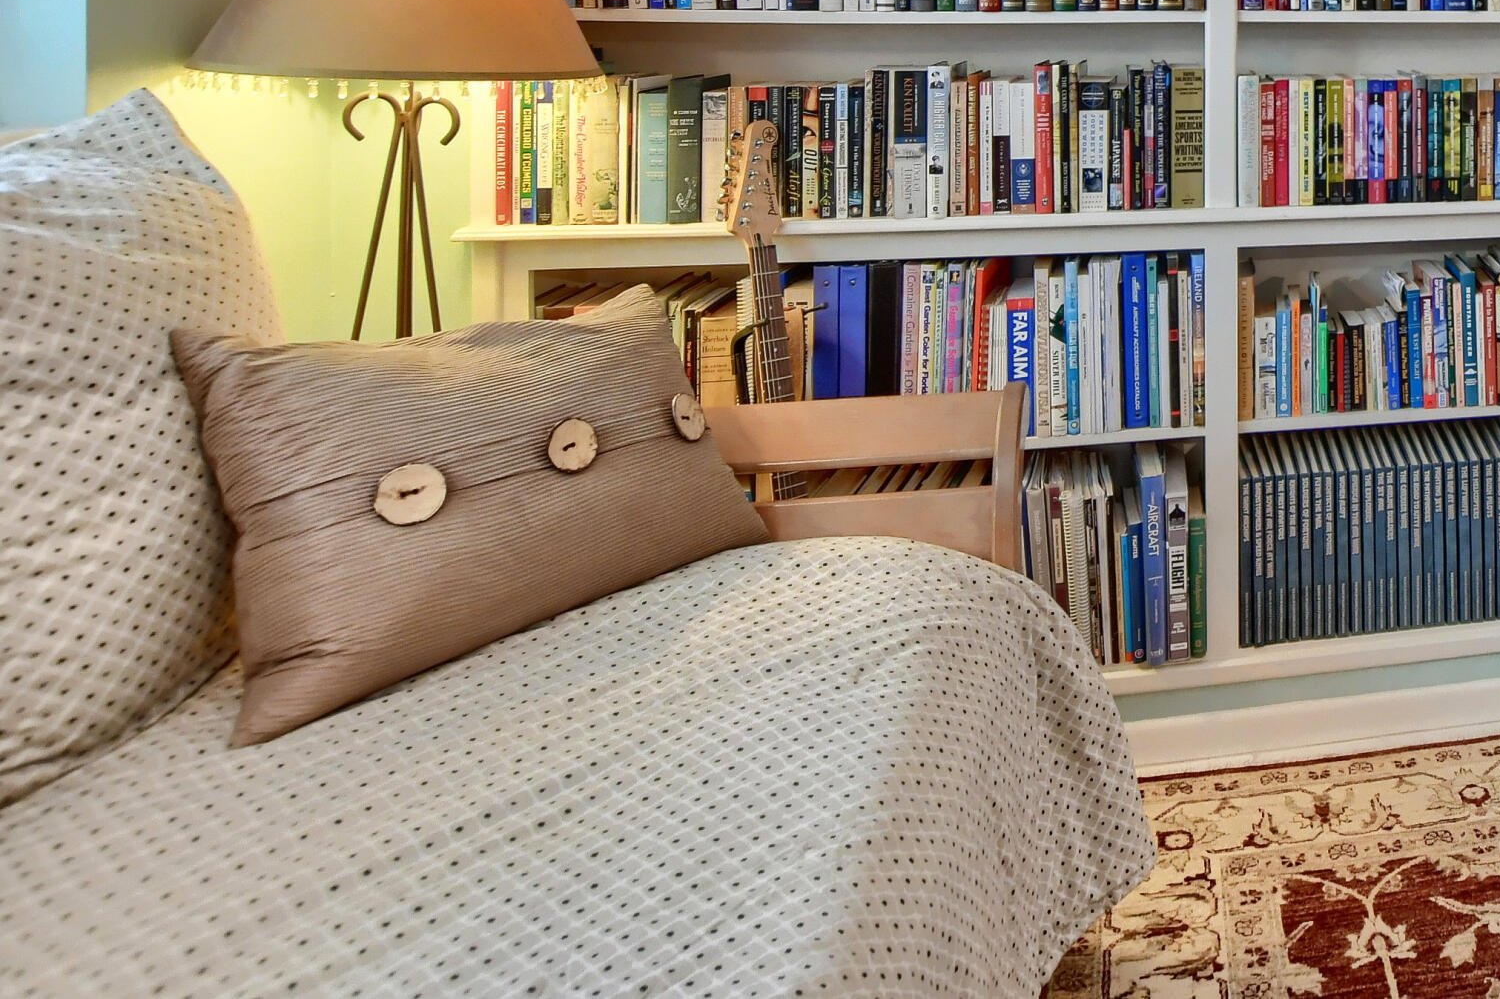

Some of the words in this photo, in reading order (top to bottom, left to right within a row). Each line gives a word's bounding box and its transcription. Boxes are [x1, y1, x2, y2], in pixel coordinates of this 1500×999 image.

[904, 78, 913, 97] KEN
[497, 110, 506, 124] THE
[577, 116, 585, 131] The
[773, 108, 778, 117] OF
[904, 98, 914, 133] FOLLETT
[934, 100, 945, 129] HIGHER
[497, 126, 506, 169] CINCINNATI
[539, 124, 549, 159] WRONG
[873, 132, 881, 154] WORLD
[1174, 132, 1202, 143] SPORTS
[574, 133, 586, 175] Complete
[804, 149, 817, 173] OUT
[1112, 139, 1120, 178] JAPANESE
[497, 172, 505, 190] REDS
[873, 157, 881, 183] WITHOUT
[575, 175, 587, 208] Walker
[785, 170, 800, 202] Aloft
[906, 275, 916, 318] Container
[924, 285, 932, 304] Best
[1194, 266, 1204, 302] IRELAND
[923, 305, 931, 334] Garden
[1013, 312, 1027, 344] FAR
[1132, 306, 1140, 337] AIRCRAFT
[905, 321, 915, 357] Gardens
[922, 336, 931, 357] Color
[1013, 346, 1028, 379] AIM
[1037, 326, 1048, 386] AVIATION
[904, 369, 914, 393] FLOR
[921, 371, 929, 394] Florid
[1038, 391, 1048, 416] USA
[1147, 504, 1160, 556] AIRCRAFT
[1171, 553, 1184, 590] FLIGHT
